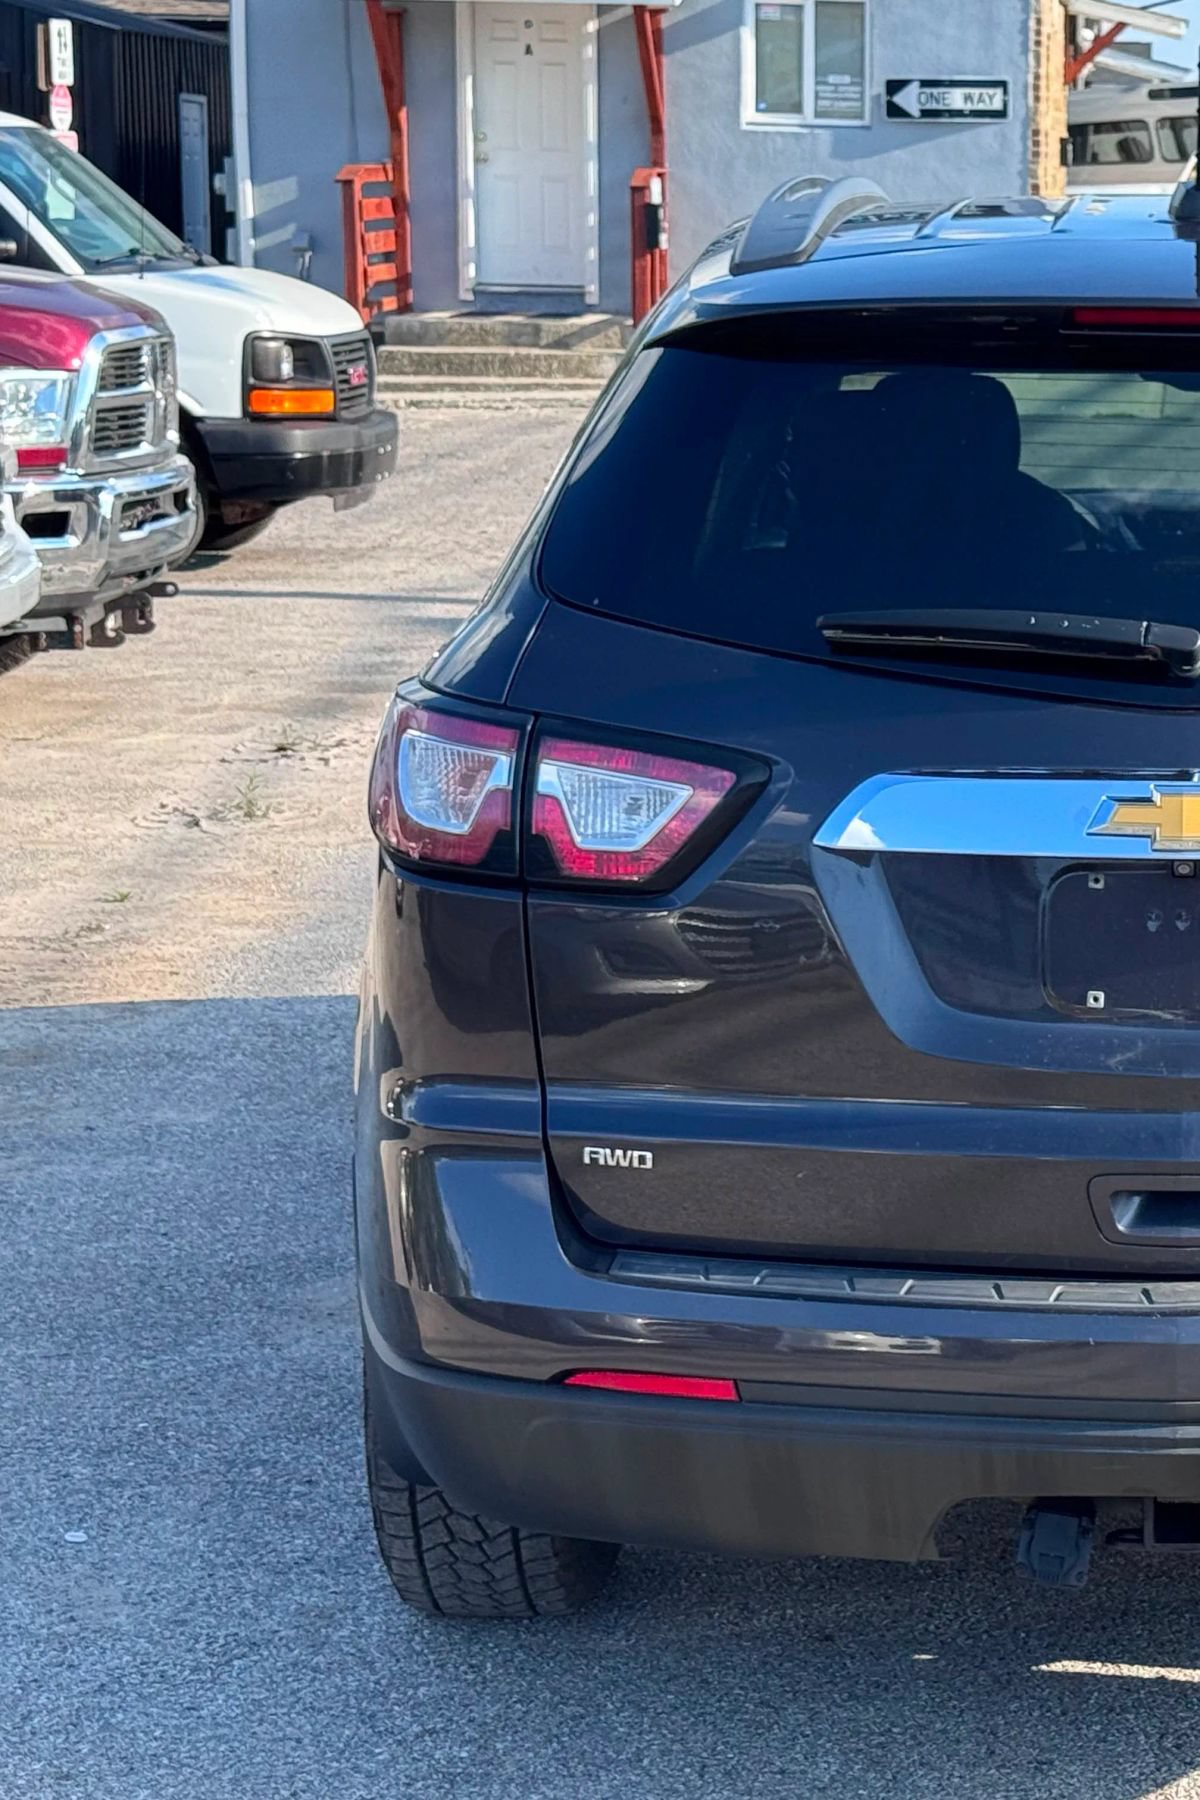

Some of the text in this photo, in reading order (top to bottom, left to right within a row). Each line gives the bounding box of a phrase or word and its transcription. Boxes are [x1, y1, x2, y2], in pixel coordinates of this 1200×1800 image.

[918, 91, 998, 106] ONE WAY
[583, 1146, 653, 1169] AWD
